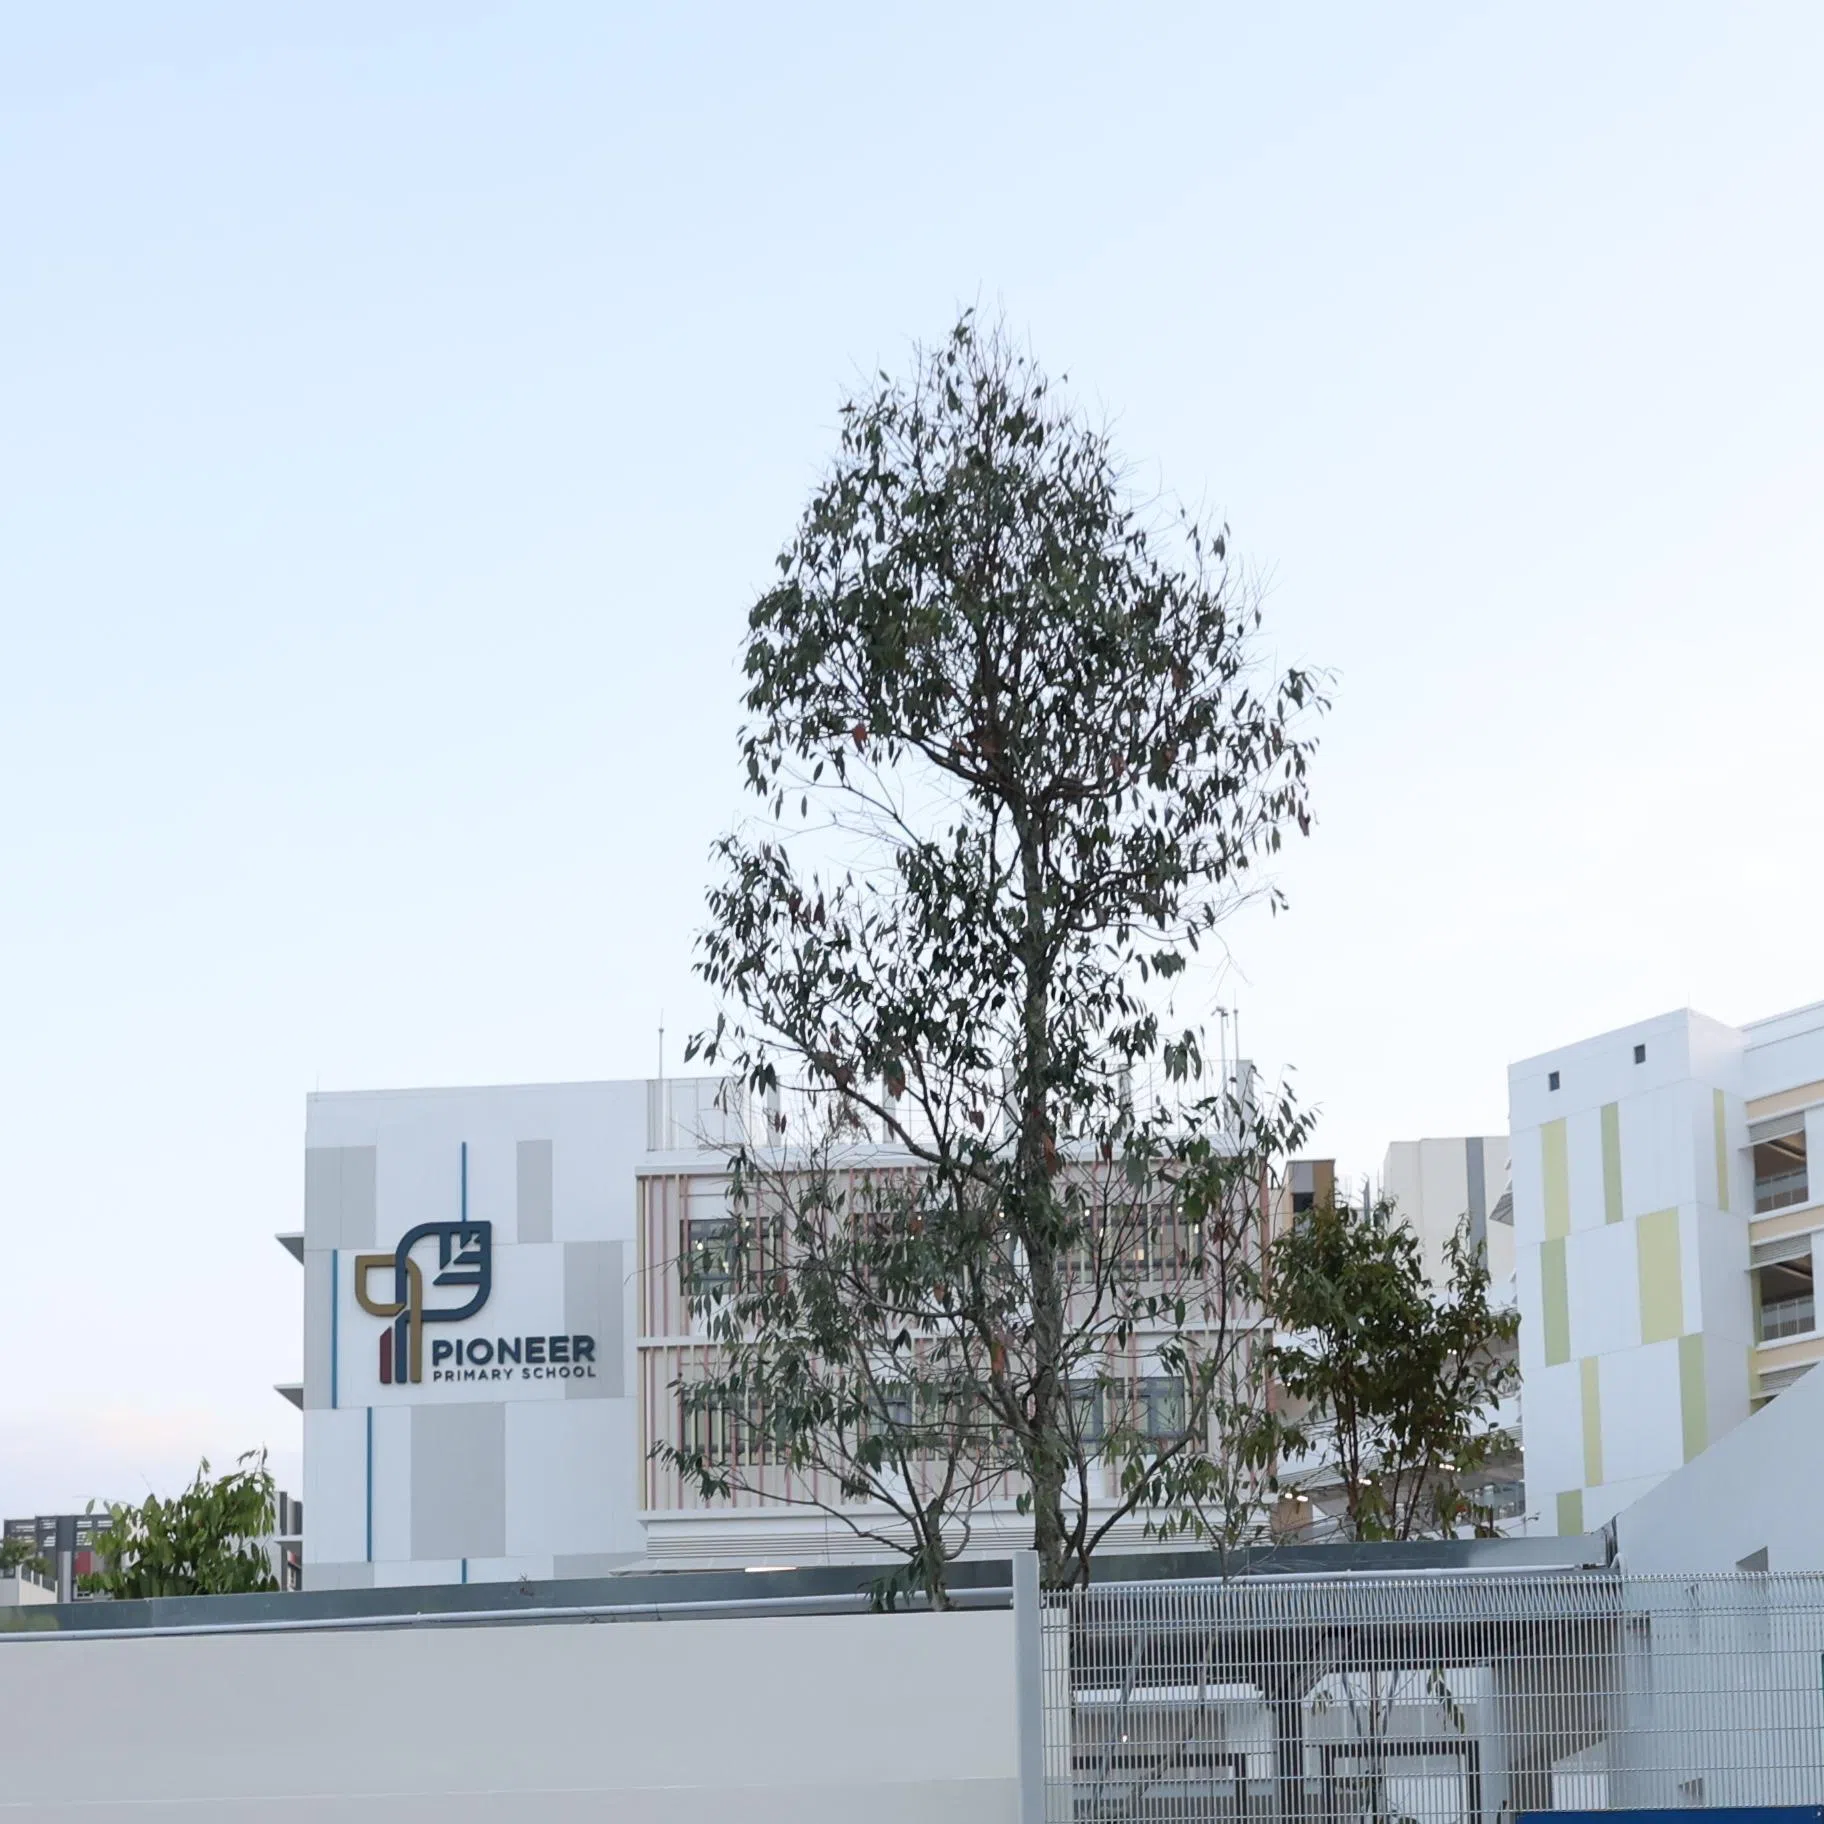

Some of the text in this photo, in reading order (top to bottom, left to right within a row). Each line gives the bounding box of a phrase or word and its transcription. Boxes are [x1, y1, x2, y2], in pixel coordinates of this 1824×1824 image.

[432, 1335, 595, 1366] PIONEER
[433, 1366, 596, 1382] PRIMARY SCHOOL
